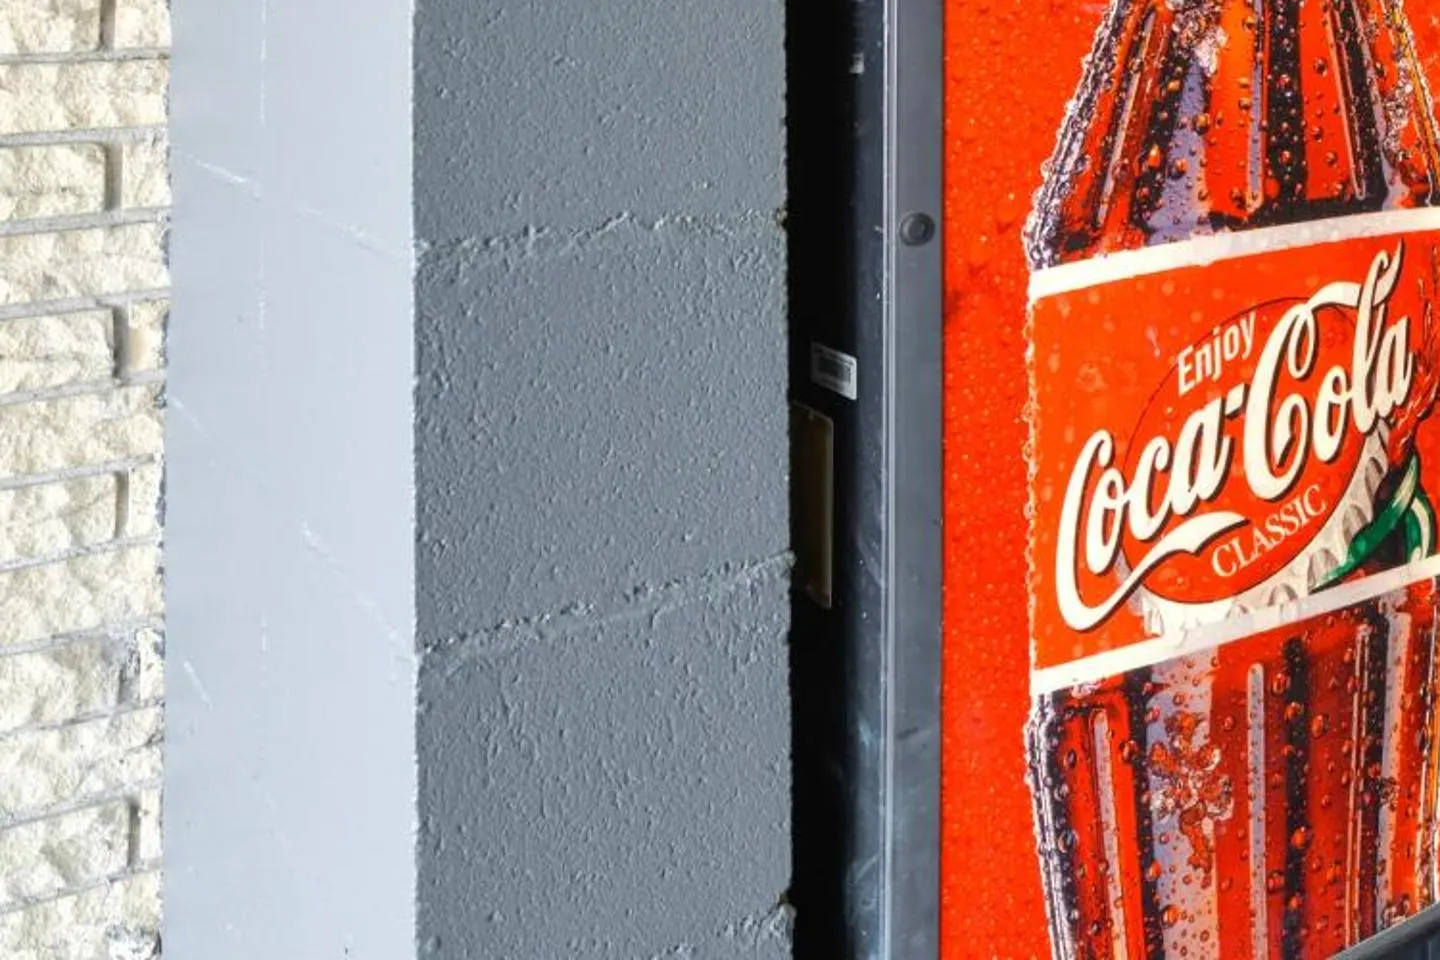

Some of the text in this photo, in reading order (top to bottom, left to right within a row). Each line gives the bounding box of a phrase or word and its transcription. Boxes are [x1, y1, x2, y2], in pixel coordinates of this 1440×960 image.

[1177, 311, 1257, 397] Enjoy
[1054, 238, 1416, 633] Coca-Cola
[1211, 483, 1328, 579] CLASSIC
